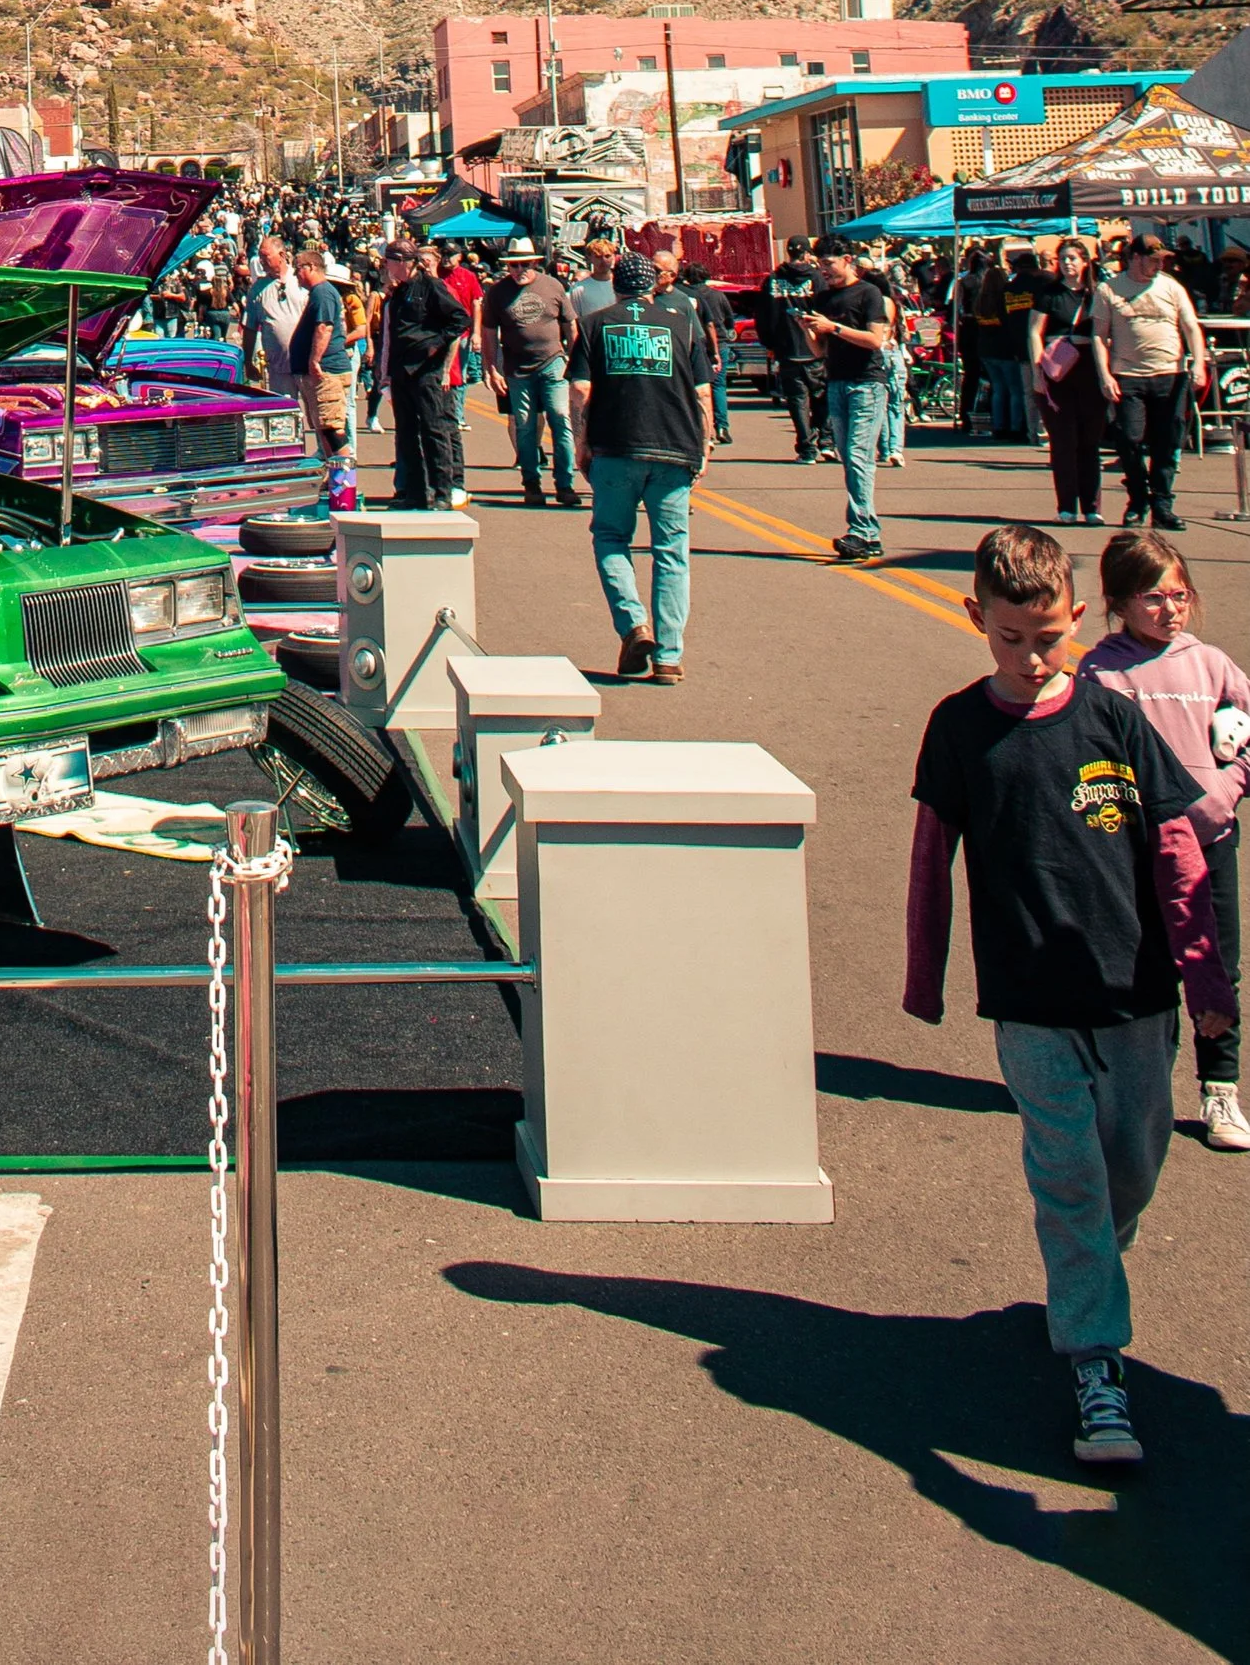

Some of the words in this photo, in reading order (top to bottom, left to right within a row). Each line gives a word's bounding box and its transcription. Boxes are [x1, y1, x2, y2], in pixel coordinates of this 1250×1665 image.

[956, 88, 992, 100] BMO
[958, 113, 991, 123] Banking
[993, 112, 1018, 121] Center
[1172, 113, 1232, 135] BUILD
[1141, 147, 1204, 163] BUILD
[1120, 187, 1188, 206] BUILD
[1197, 185, 1250, 205] YOUR
[627, 326, 649, 340] LOS
[607, 334, 669, 361] CHINGONES
[1079, 760, 1136, 785] LOWRIDER
